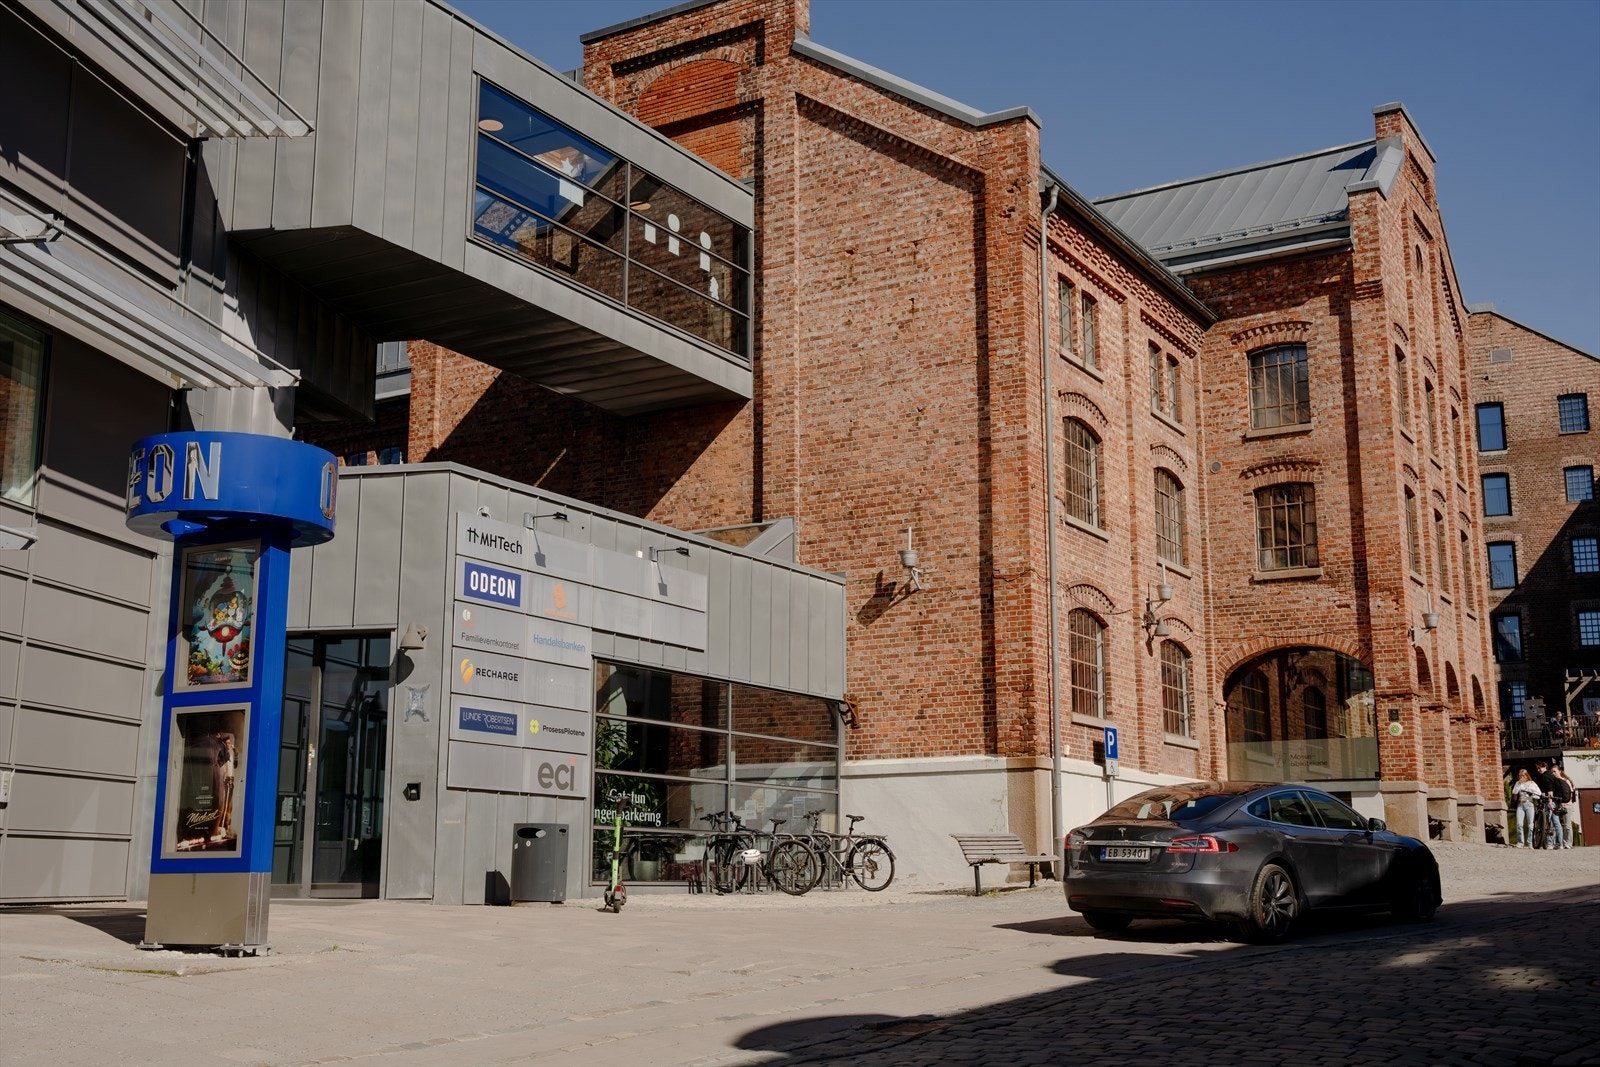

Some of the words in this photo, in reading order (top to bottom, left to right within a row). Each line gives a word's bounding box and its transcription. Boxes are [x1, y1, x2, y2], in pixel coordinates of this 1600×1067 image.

[127, 441, 222, 510] EON
[480, 531, 523, 555] MHTech
[470, 570, 516, 600] ODEON
[533, 633, 586, 653] Handelsbanken
[475, 667, 519, 682] RECHARGE
[462, 711, 482, 722] LUNDE
[482, 713, 515, 728] ROBERTSEN
[542, 724, 586, 737] ProsessPilotene
[1107, 731, 1115, 755] P
[537, 757, 576, 792] eci
[186, 809, 220, 827] Michael
[594, 808, 617, 824] ngen
[1108, 848, 1119, 858] EB
[1121, 848, 1147, 859] 53401
